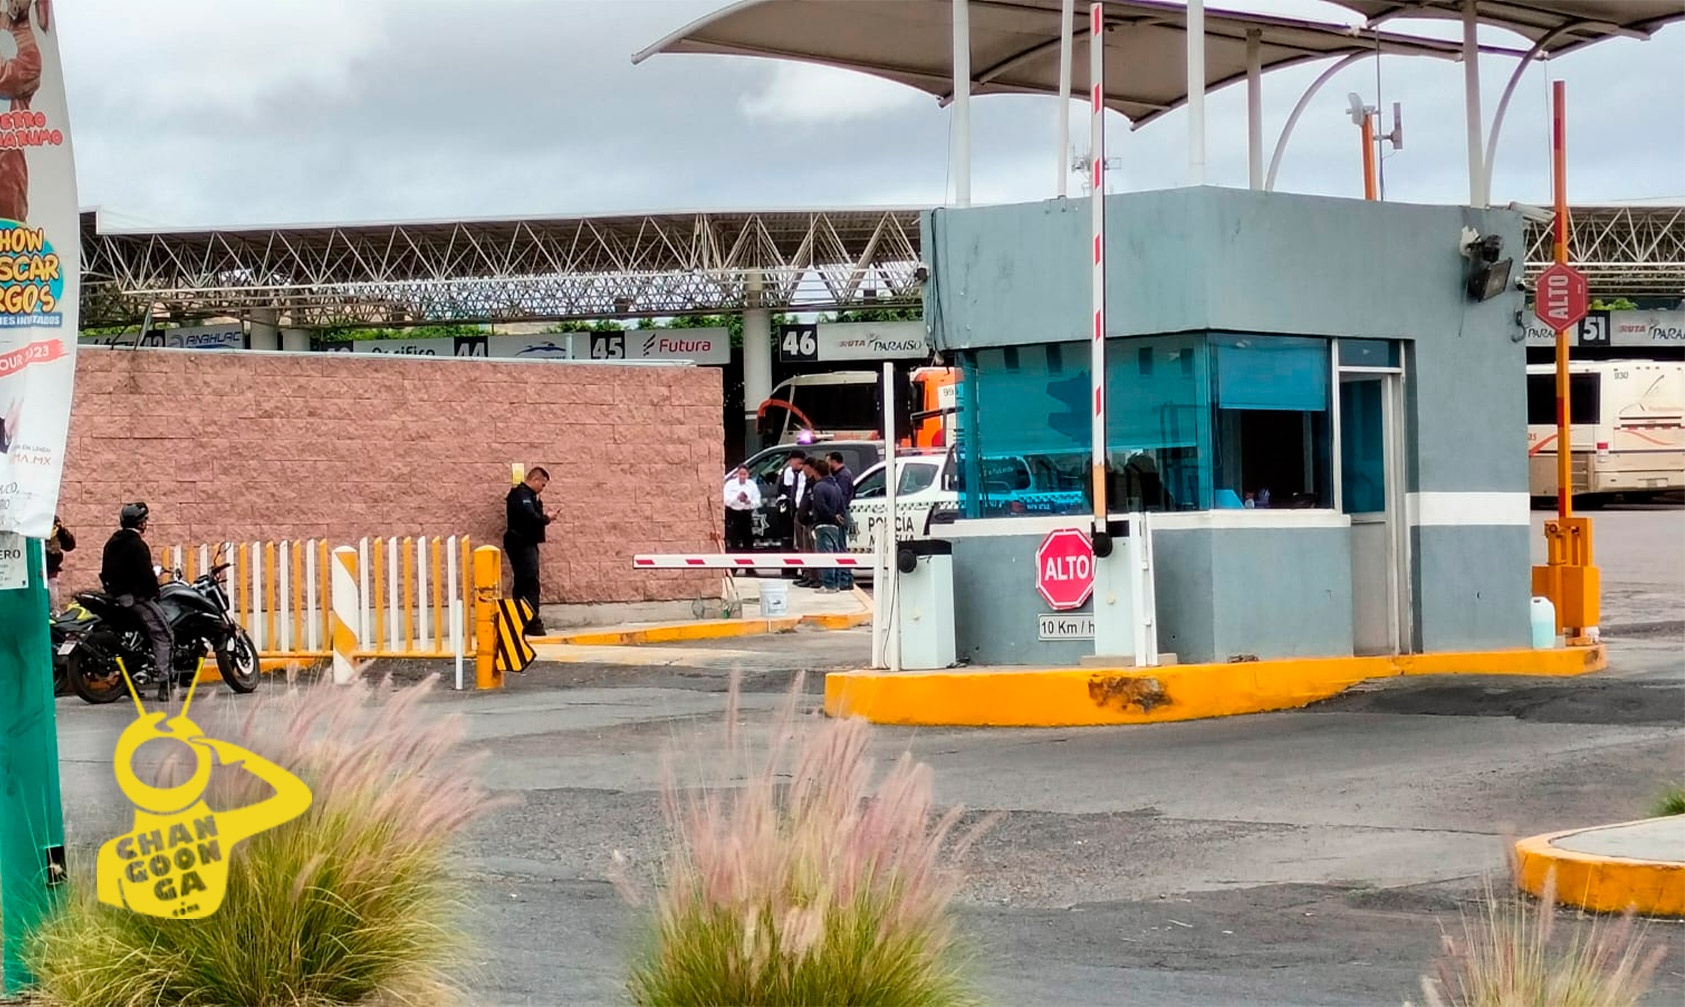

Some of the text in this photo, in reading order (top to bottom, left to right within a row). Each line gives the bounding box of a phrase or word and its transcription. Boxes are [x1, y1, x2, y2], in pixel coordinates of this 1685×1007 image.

[1548, 275, 1569, 319] ALTO
[1583, 316, 1606, 341] 51
[592, 337, 623, 359] 45
[659, 338, 711, 353] Futura
[782, 331, 816, 356] 46
[1044, 555, 1089, 581] ALTO
[1041, 621, 1054, 634] 10
[1058, 620, 1077, 634] Km
